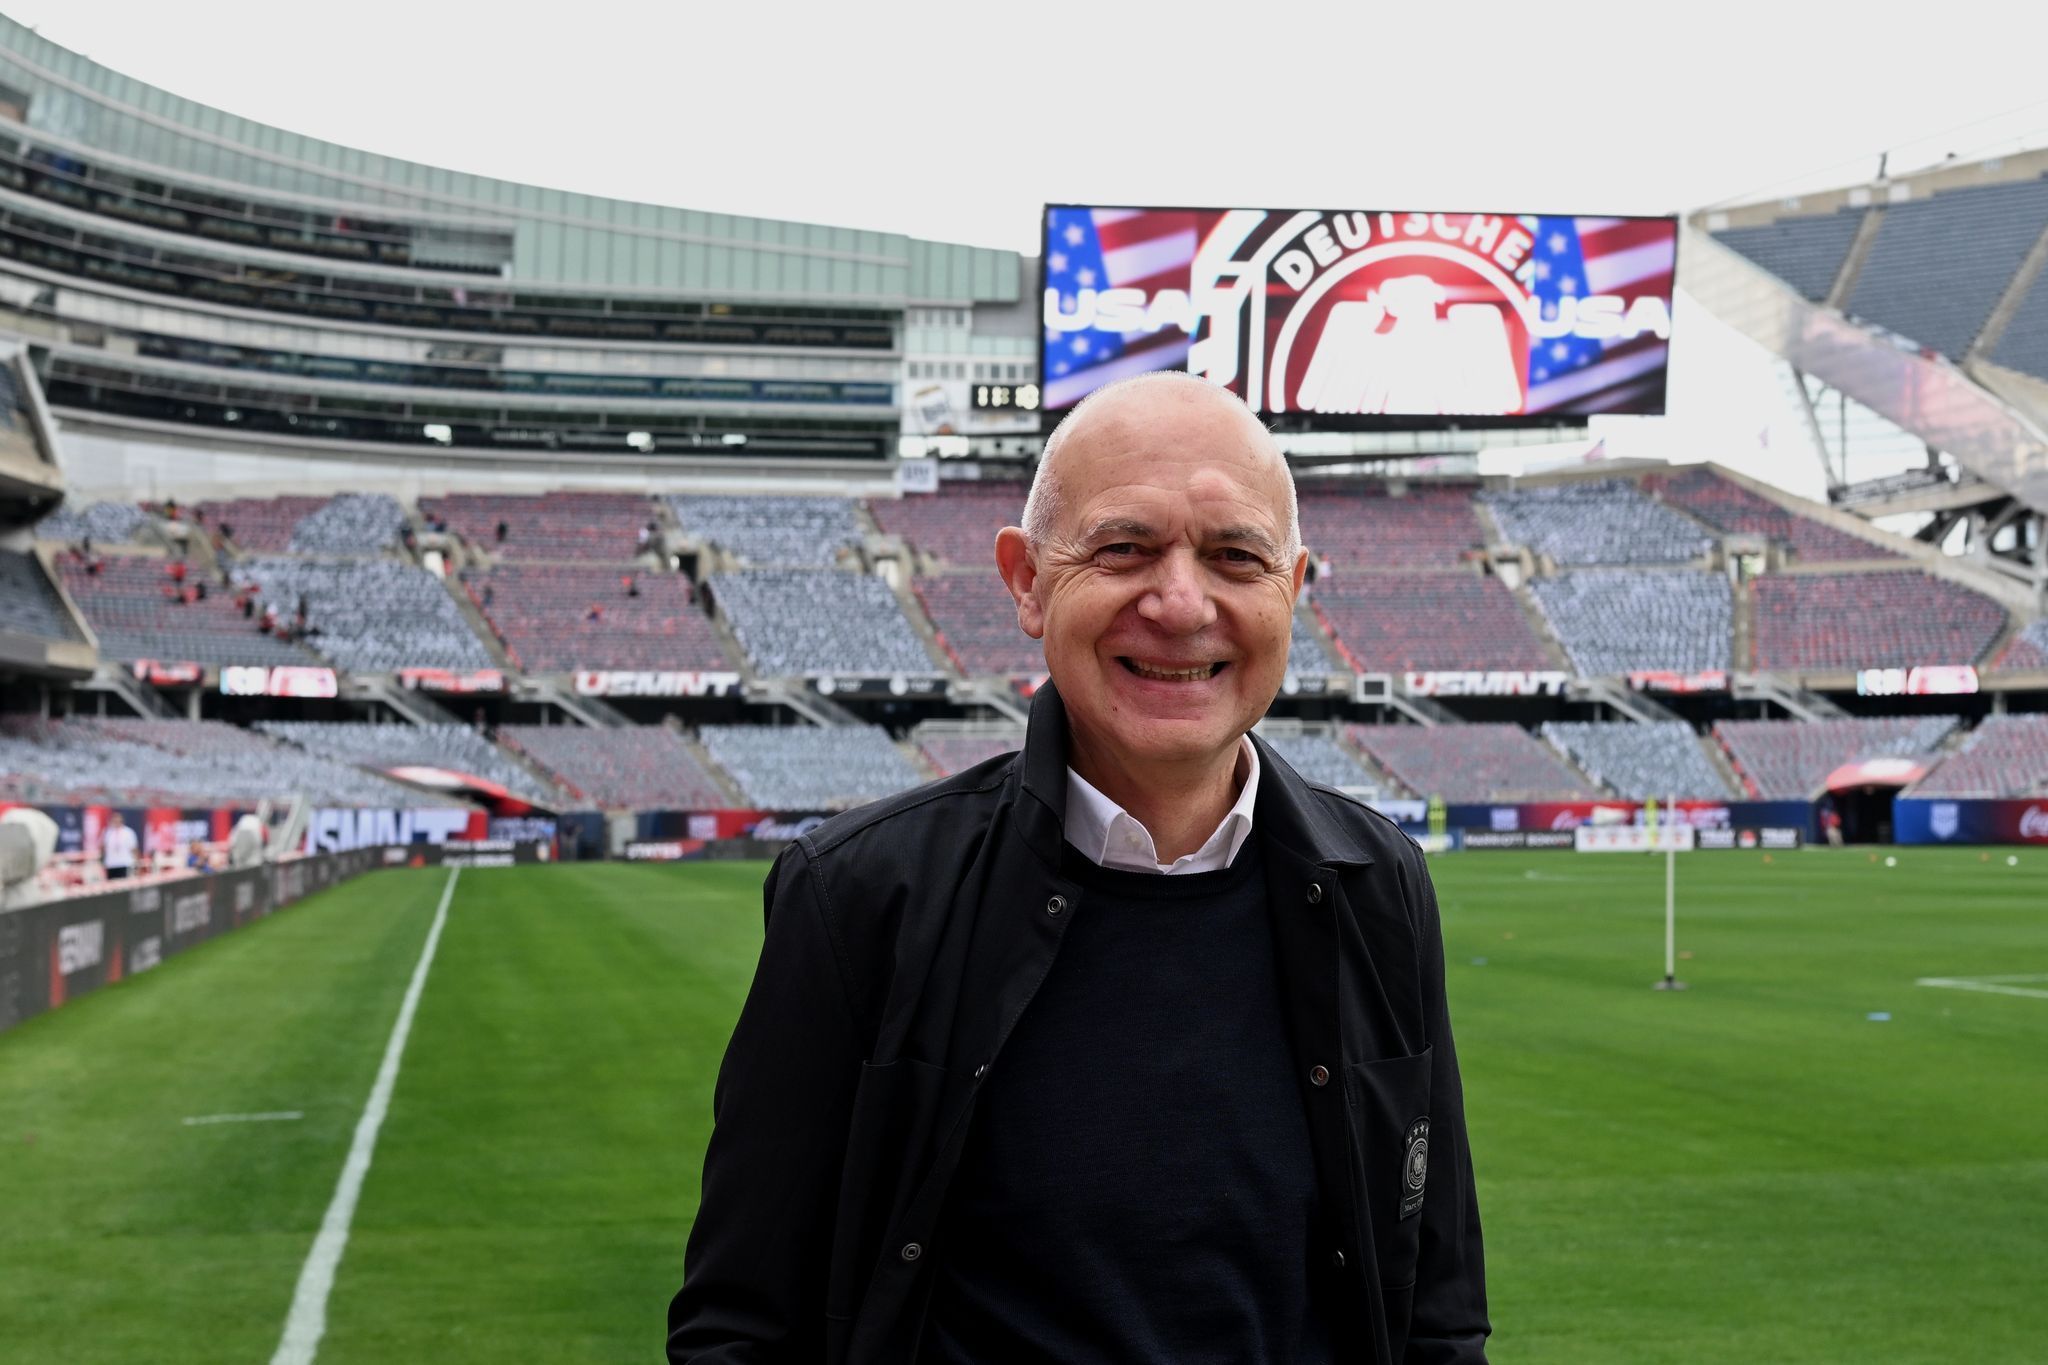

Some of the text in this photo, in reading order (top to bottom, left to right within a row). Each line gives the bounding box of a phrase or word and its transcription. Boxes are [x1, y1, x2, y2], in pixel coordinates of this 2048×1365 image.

[1043, 287, 1193, 334] USA
[1527, 295, 1671, 340] USA
[576, 670, 737, 697] USMNT
[1405, 671, 1567, 696] USMNT
[306, 808, 469, 856] SMNT
